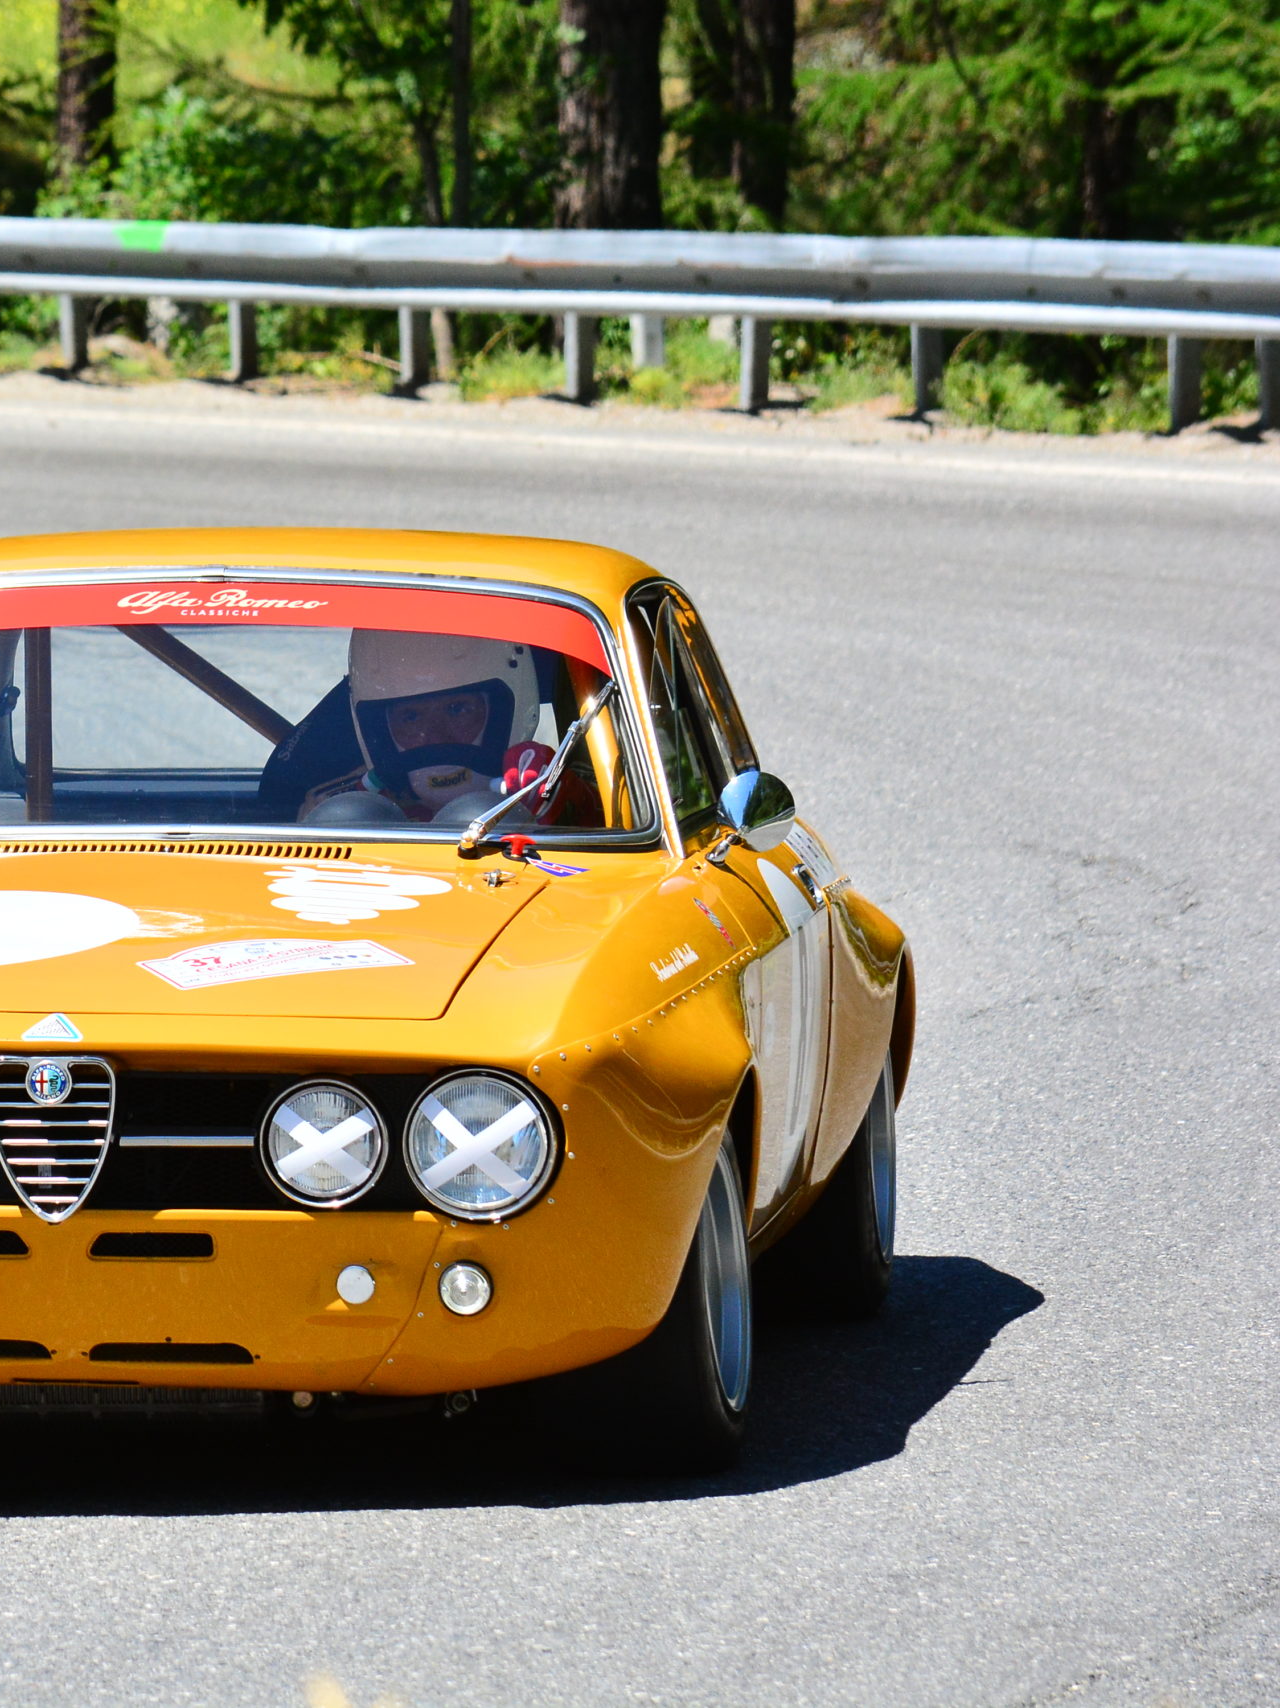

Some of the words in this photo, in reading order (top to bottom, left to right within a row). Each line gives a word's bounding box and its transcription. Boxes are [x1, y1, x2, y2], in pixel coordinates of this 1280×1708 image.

[117, 590, 203, 614] Alfa
[205, 588, 329, 609] Romeo
[182, 956, 221, 967] 37
[35, 1091, 61, 1100] MILANO
